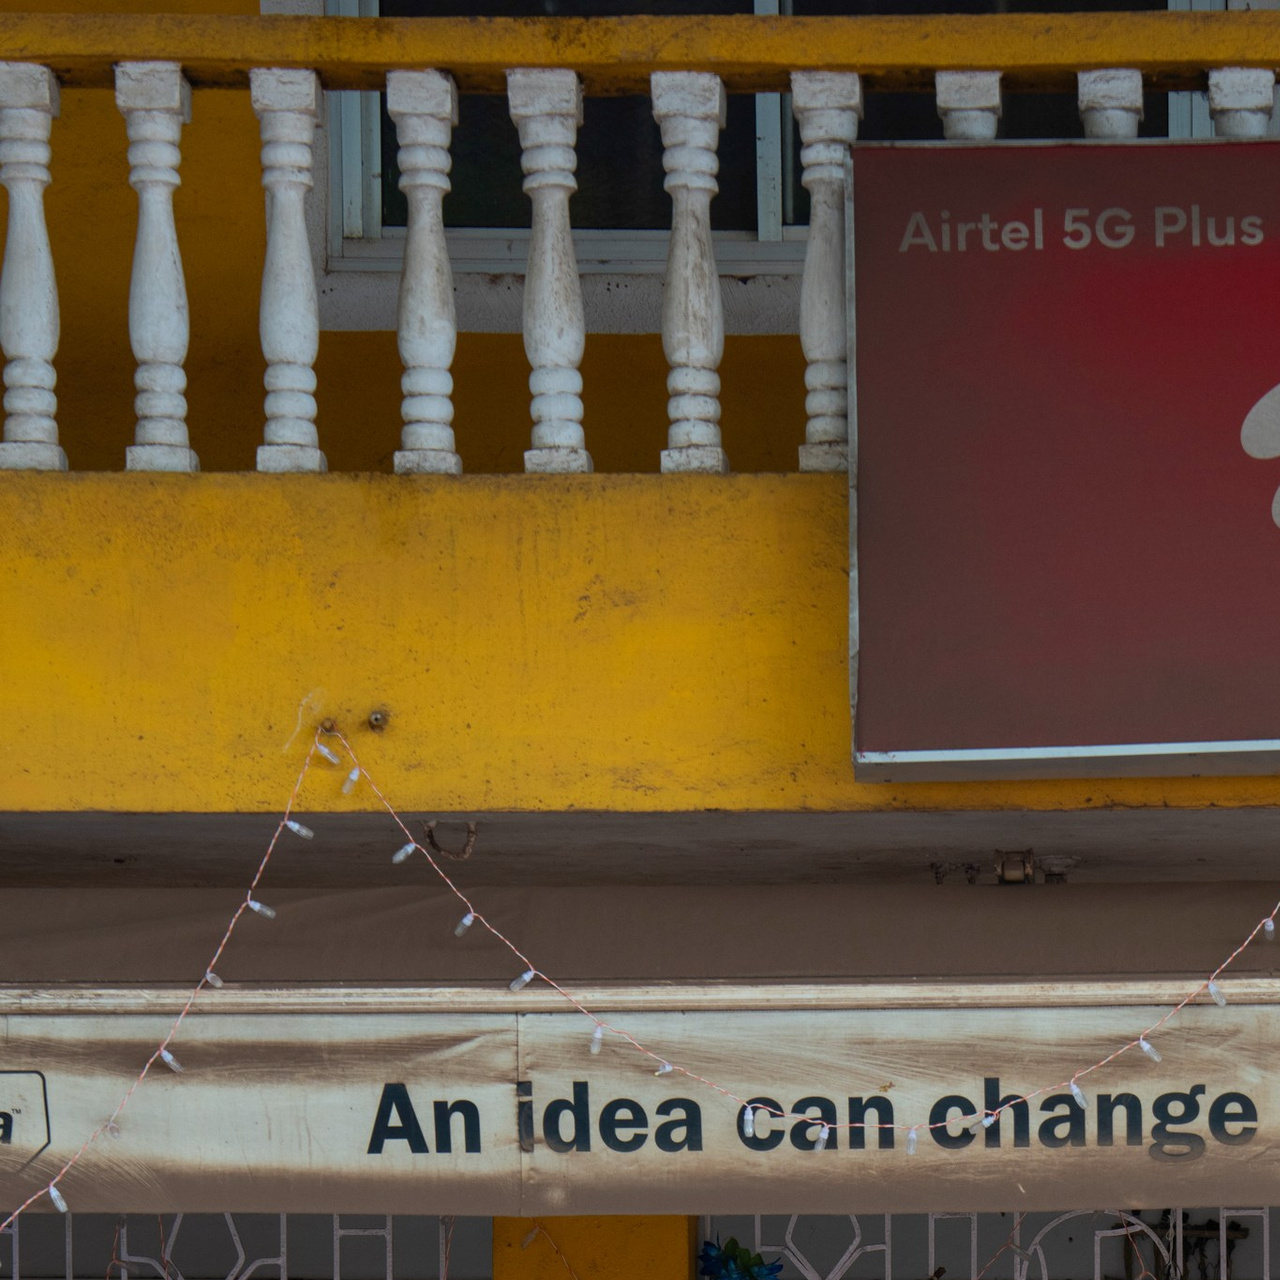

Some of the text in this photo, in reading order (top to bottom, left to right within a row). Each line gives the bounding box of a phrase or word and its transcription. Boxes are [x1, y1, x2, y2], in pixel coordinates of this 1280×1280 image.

[899, 204, 1265, 253] Airtel 5G Plus
[367, 1082, 482, 1154] An
[516, 1080, 704, 1153] idea
[736, 1095, 896, 1152] can
[928, 1077, 1259, 1162] change
